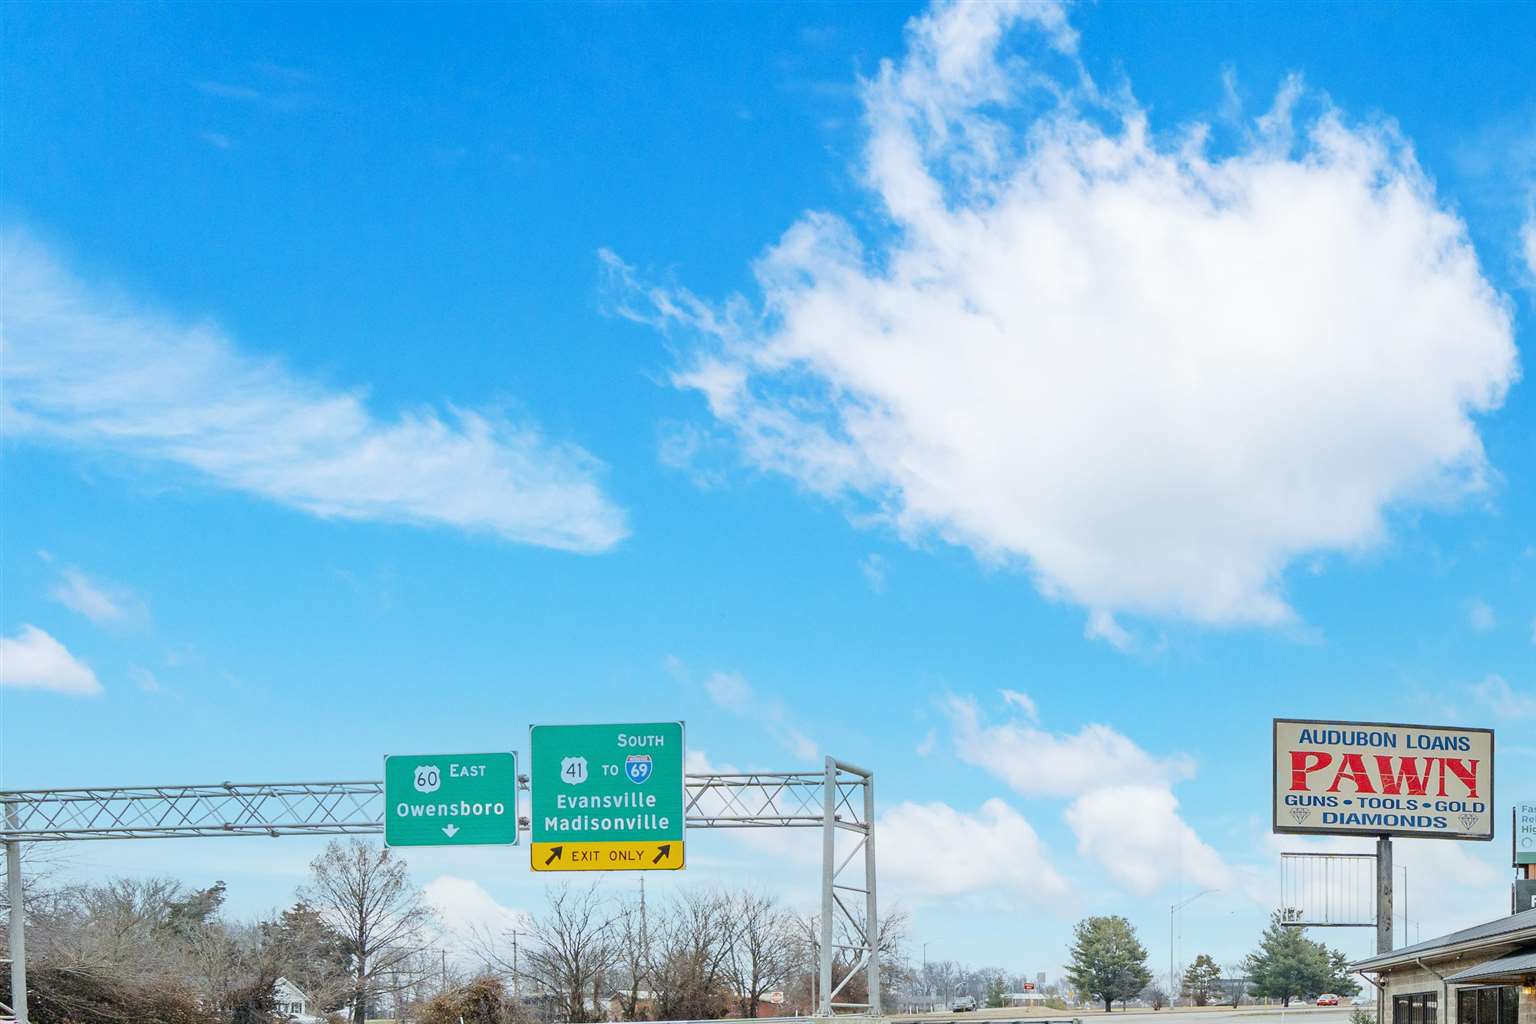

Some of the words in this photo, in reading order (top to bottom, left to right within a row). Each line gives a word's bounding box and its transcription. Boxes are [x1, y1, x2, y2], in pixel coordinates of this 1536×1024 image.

[617, 734, 664, 747] SOUTH
[1299, 729, 1396, 748] AUDUBON
[1406, 734, 1471, 752] LOANS
[417, 771, 437, 787] 60
[449, 764, 486, 777] EAST
[566, 763, 582, 777] 41
[601, 765, 619, 776] TO
[630, 764, 648, 778] 69
[1289, 751, 1480, 798] PAWN
[397, 801, 504, 817] Owensboro
[557, 792, 656, 809] Evansville
[1284, 794, 1339, 808] GUNS
[1357, 797, 1418, 811] TOOLS
[1435, 800, 1485, 813] GOLD
[545, 814, 669, 831] Madisonville
[1322, 812, 1448, 829] DIAMONDS
[571, 850, 600, 861] EXIT
[609, 850, 644, 861] ONLY
